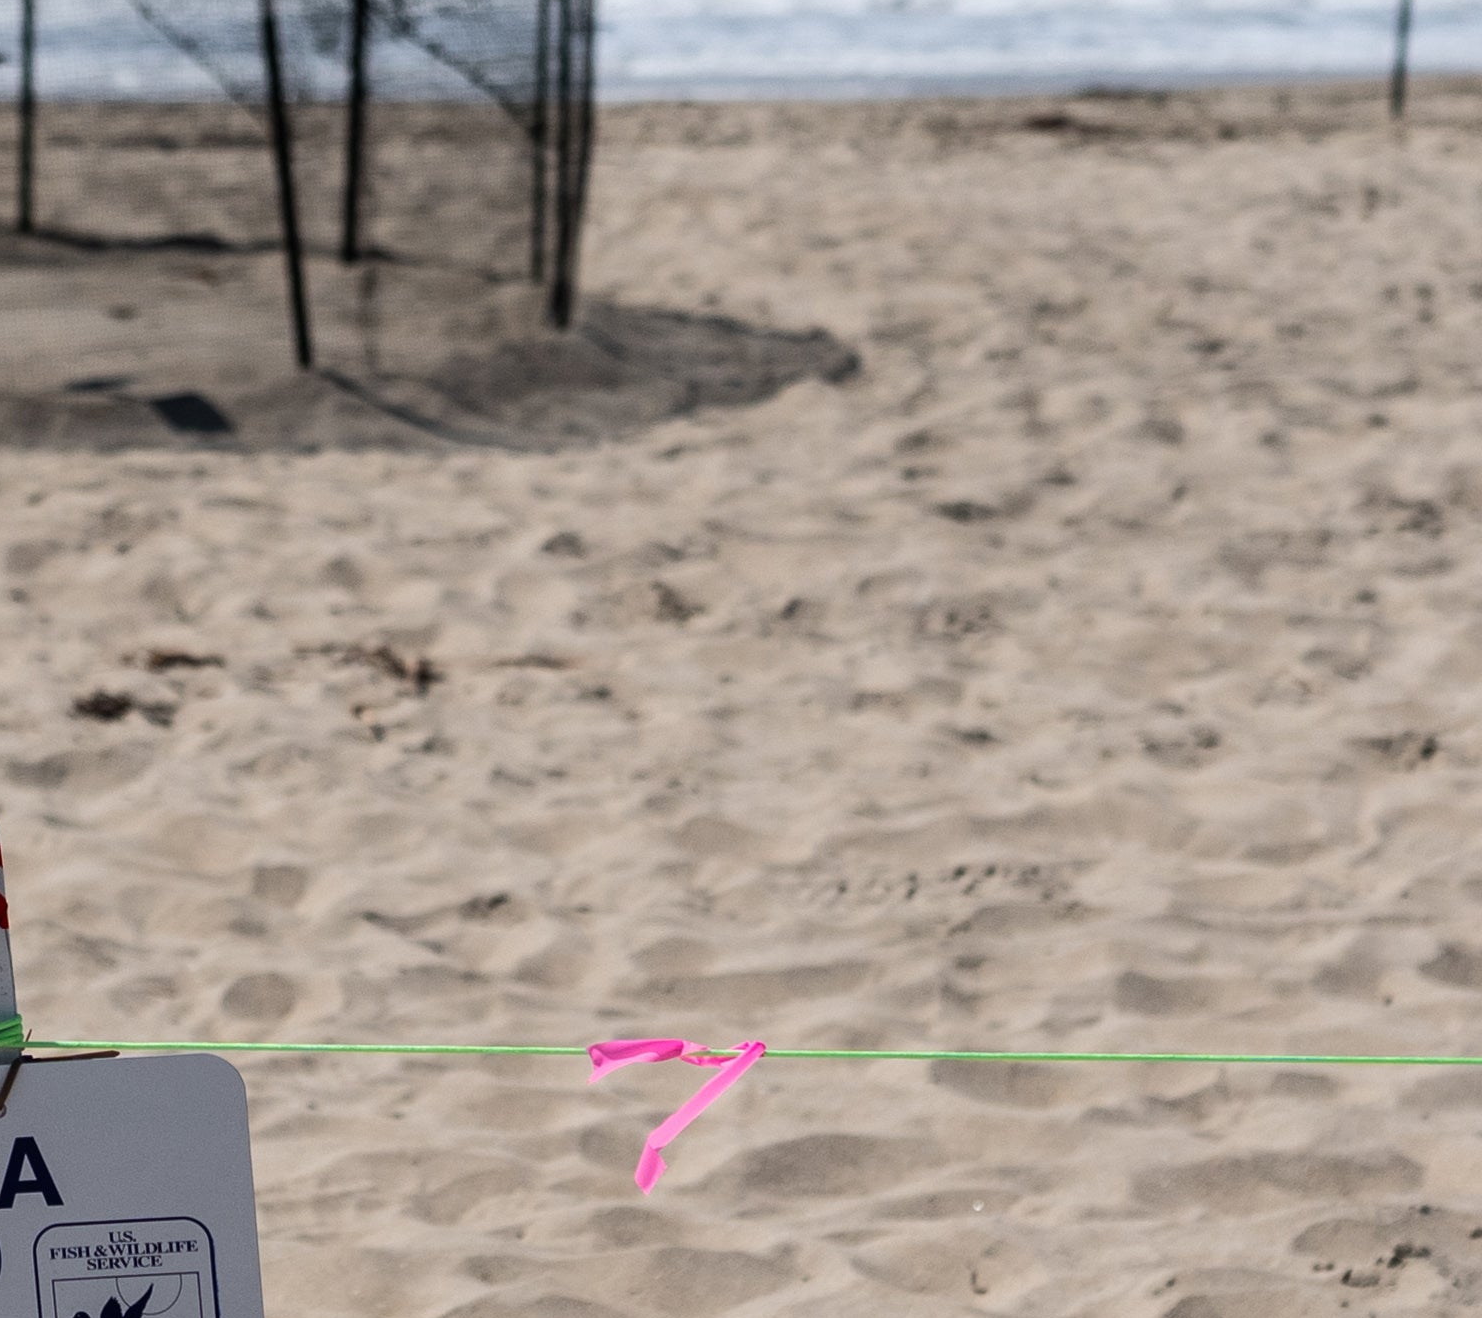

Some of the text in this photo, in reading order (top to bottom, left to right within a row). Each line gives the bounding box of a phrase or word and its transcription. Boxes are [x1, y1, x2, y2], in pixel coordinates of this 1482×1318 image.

[108, 1231, 136, 1244] U.S.
[49, 1240, 199, 1260] FISH & WILDLIFE
[86, 1255, 163, 1271] SERVICE
